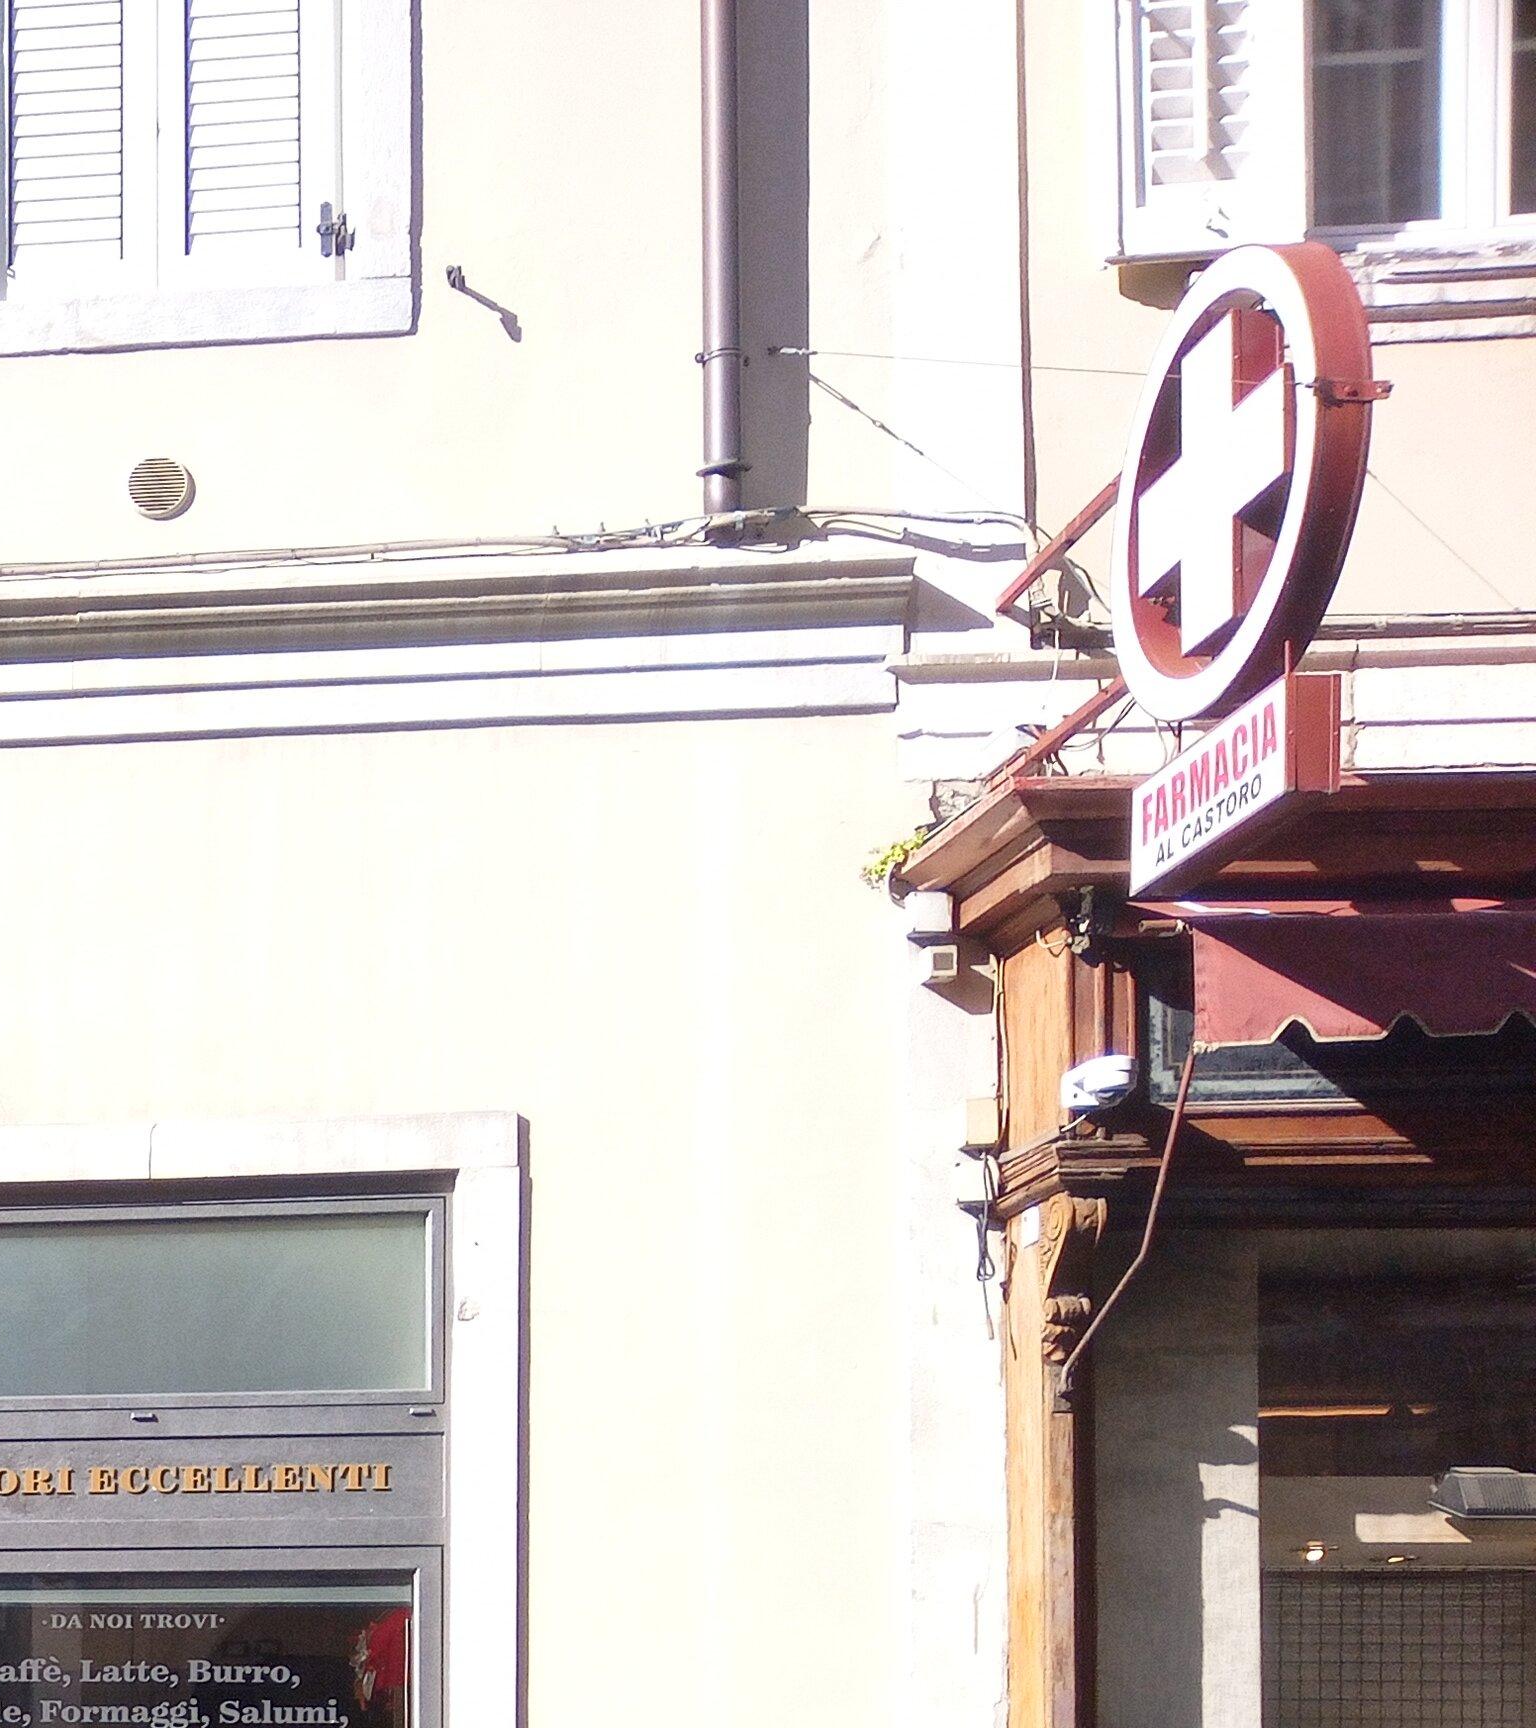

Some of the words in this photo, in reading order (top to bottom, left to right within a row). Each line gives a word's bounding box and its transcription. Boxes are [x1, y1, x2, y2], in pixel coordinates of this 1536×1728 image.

[1142, 701, 1278, 847] FARMACIA
[1155, 838, 1174, 867] AL
[1181, 773, 1262, 849] CASTORO
[88, 1462, 393, 1496] ECCELLENTI
[89, 1613, 134, 1630] NOI
[79, 1658, 179, 1687] Latte,
[187, 1658, 302, 1688] Burro,
[218, 1698, 350, 1728] Salumi,
